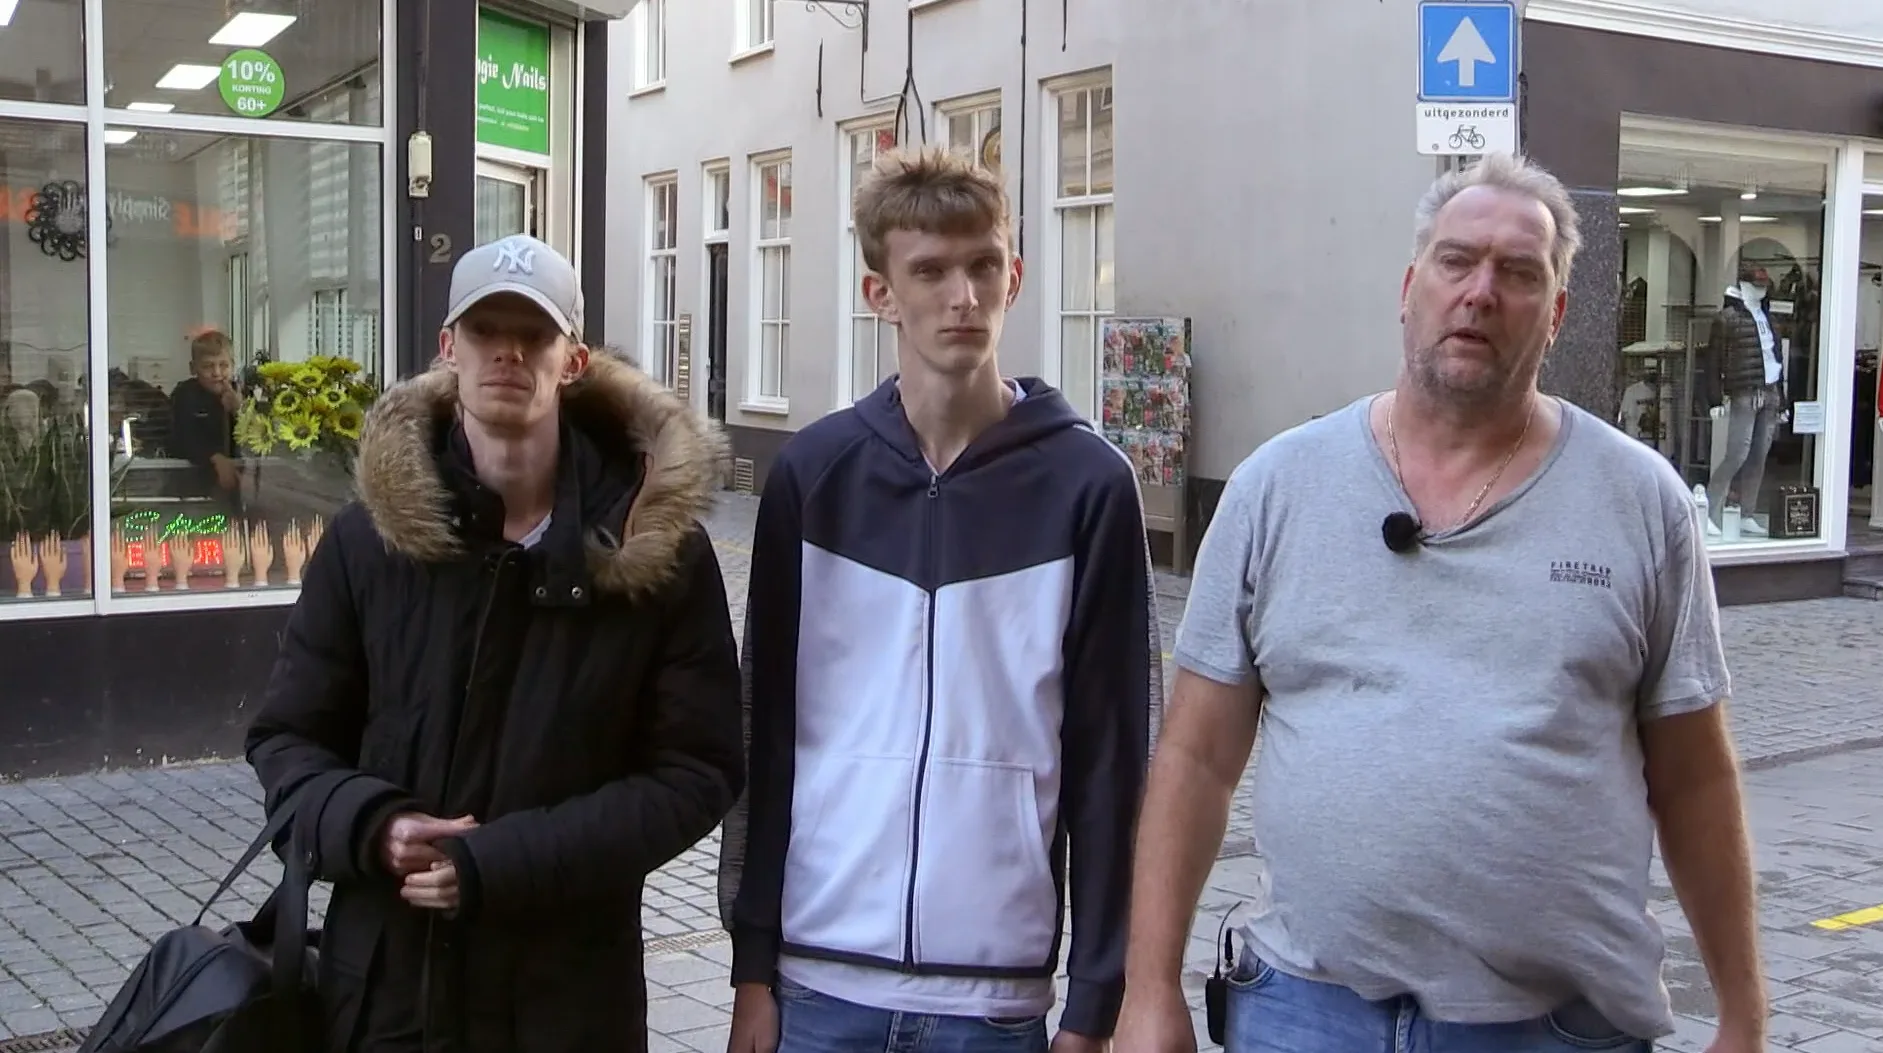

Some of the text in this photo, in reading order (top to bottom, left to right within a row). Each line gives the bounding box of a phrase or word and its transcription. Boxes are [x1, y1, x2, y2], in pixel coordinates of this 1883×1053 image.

[227, 60, 276, 83] 10%
[502, 62, 547, 90] Nails
[232, 84, 272, 95] KORTING
[237, 96, 267, 112] 60+
[1424, 108, 1509, 120] uitgezonderd
[429, 233, 452, 264] 2
